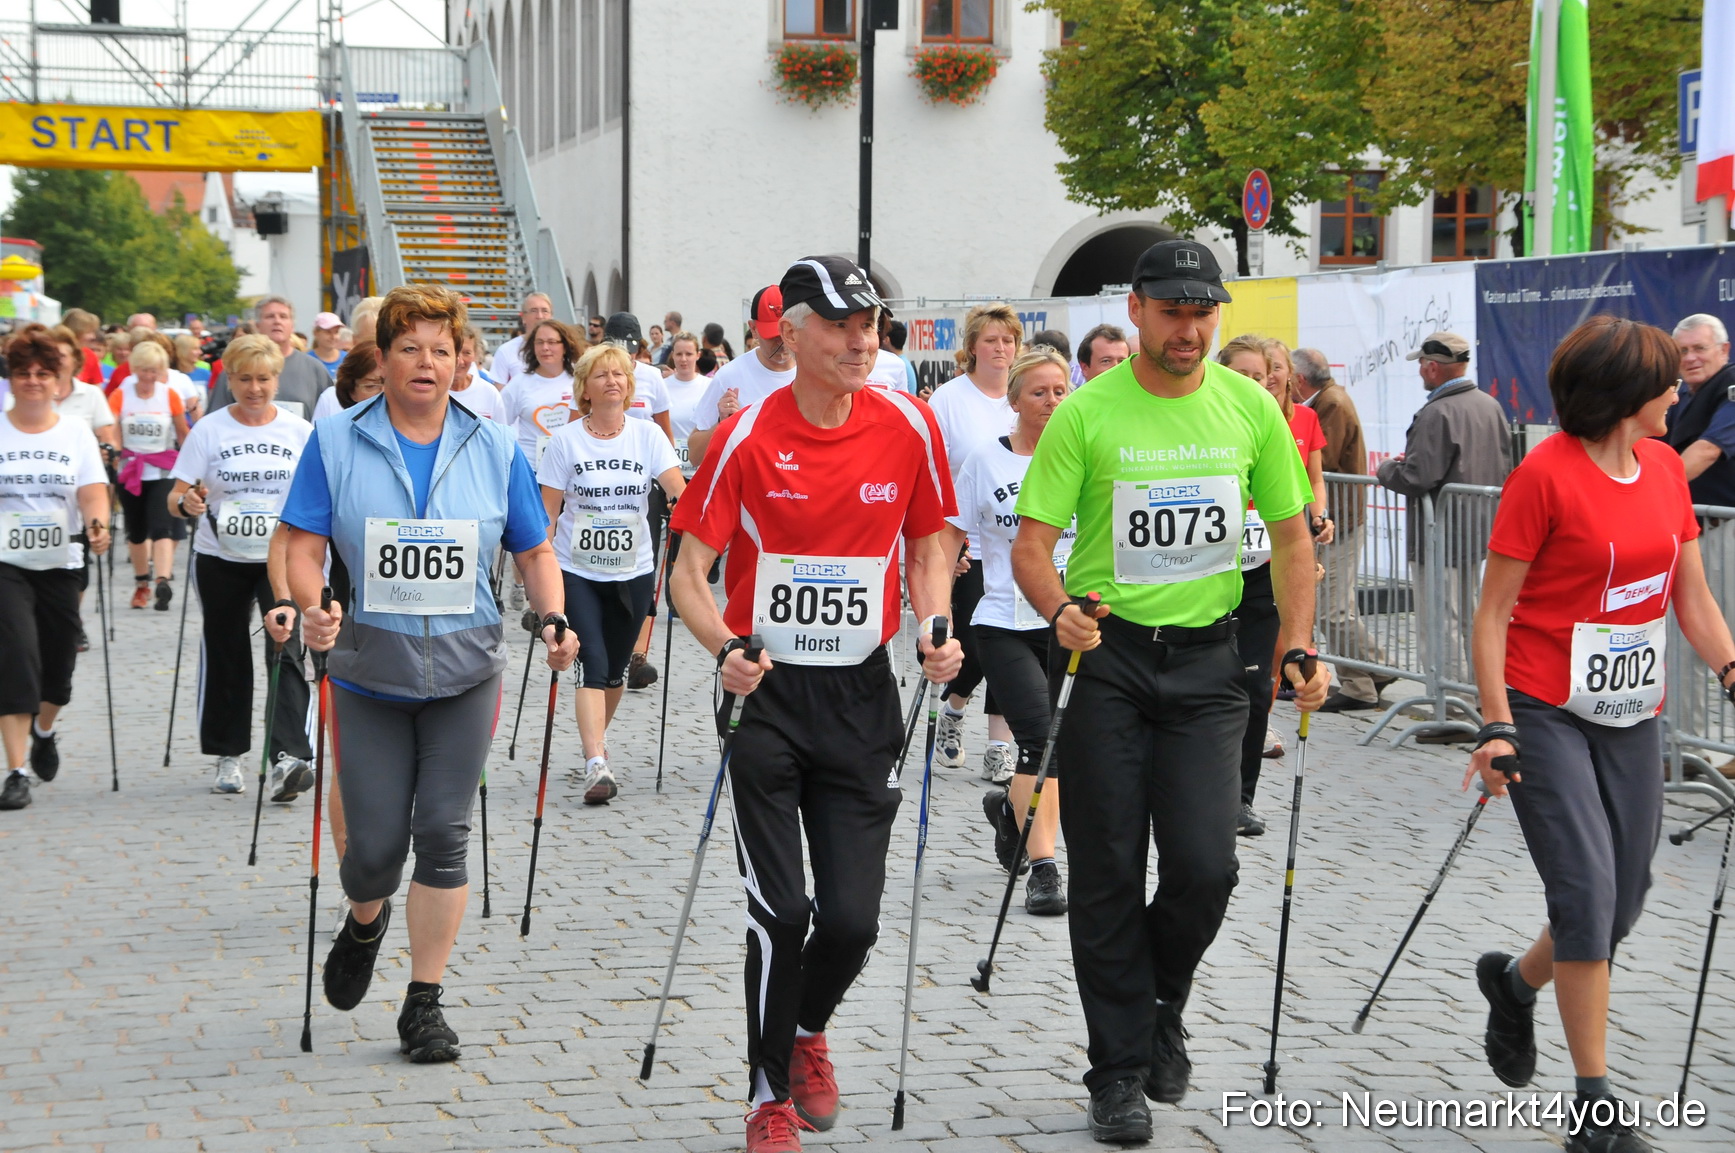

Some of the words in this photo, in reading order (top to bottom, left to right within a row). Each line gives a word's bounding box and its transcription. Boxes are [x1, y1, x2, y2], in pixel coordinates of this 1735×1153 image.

[30, 116, 180, 152] START
[1719, 278, 1735, 301] EU
[220, 443, 292, 460] BERGER
[574, 459, 644, 475] BERGER
[775, 462, 799, 470] erima
[574, 484, 610, 498] POWER
[614, 484, 647, 497] GIRLS
[1149, 485, 1200, 499] BOCK
[617, 503, 640, 512] talking
[398, 526, 444, 537] BOCK
[1128, 506, 1227, 548] 8073
[9, 527, 62, 550] 8090
[579, 529, 633, 551] 8063
[1118, 541, 1125, 549] N
[378, 544, 464, 580] 8065
[590, 555, 621, 566] Christl
[1150, 553, 1198, 569] Otmar
[369, 571, 375, 579] N
[793, 564, 847, 577] BOCK
[389, 584, 425, 602] Maria
[1624, 583, 1652, 600] DEHN
[769, 584, 868, 626] 8055
[758, 616, 764, 624] N
[794, 634, 840, 652] Horst
[1609, 630, 1648, 645] BOCK
[1586, 647, 1656, 693] 8002
[1593, 699, 1643, 719] Brigitte
